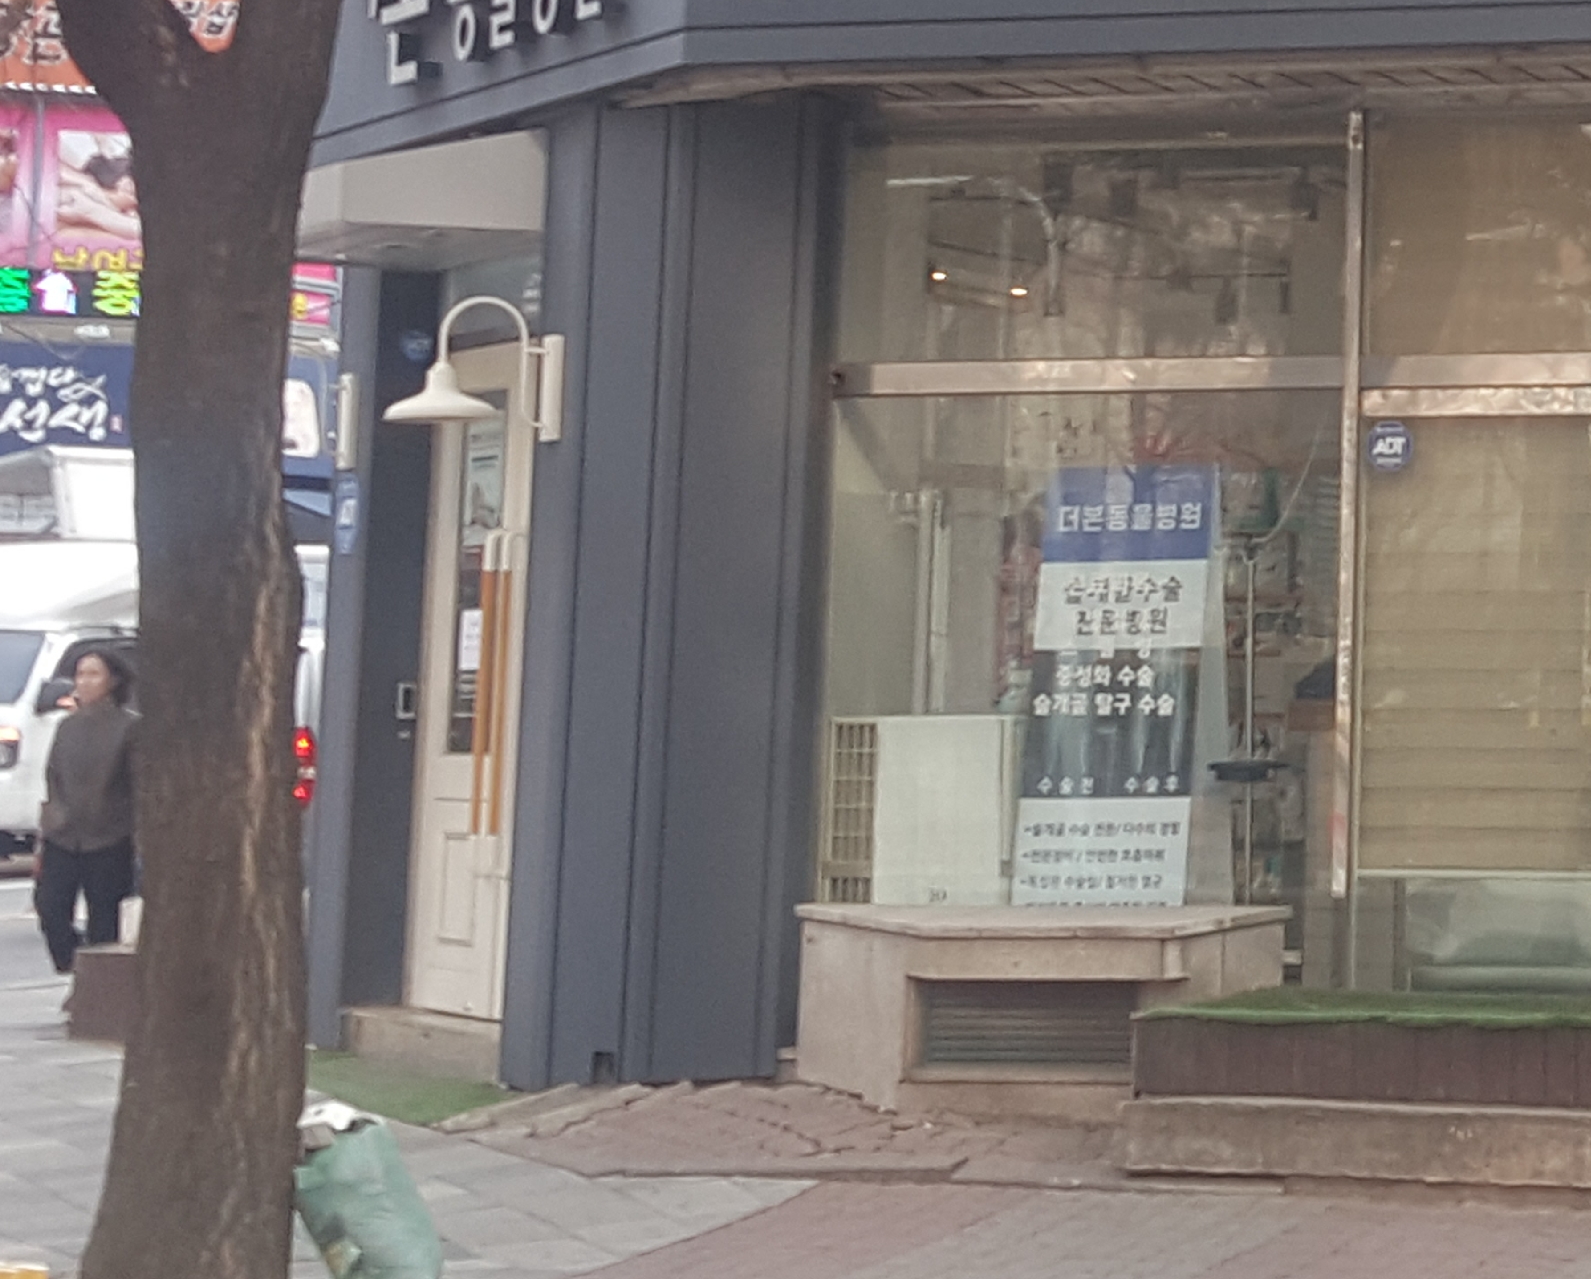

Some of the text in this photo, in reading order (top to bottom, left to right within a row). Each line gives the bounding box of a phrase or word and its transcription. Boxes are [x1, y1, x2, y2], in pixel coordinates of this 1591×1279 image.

[1371, 435, 1407, 456] ADT
[1117, 664, 1155, 688] 수술
[1138, 693, 1175, 716] 수술
